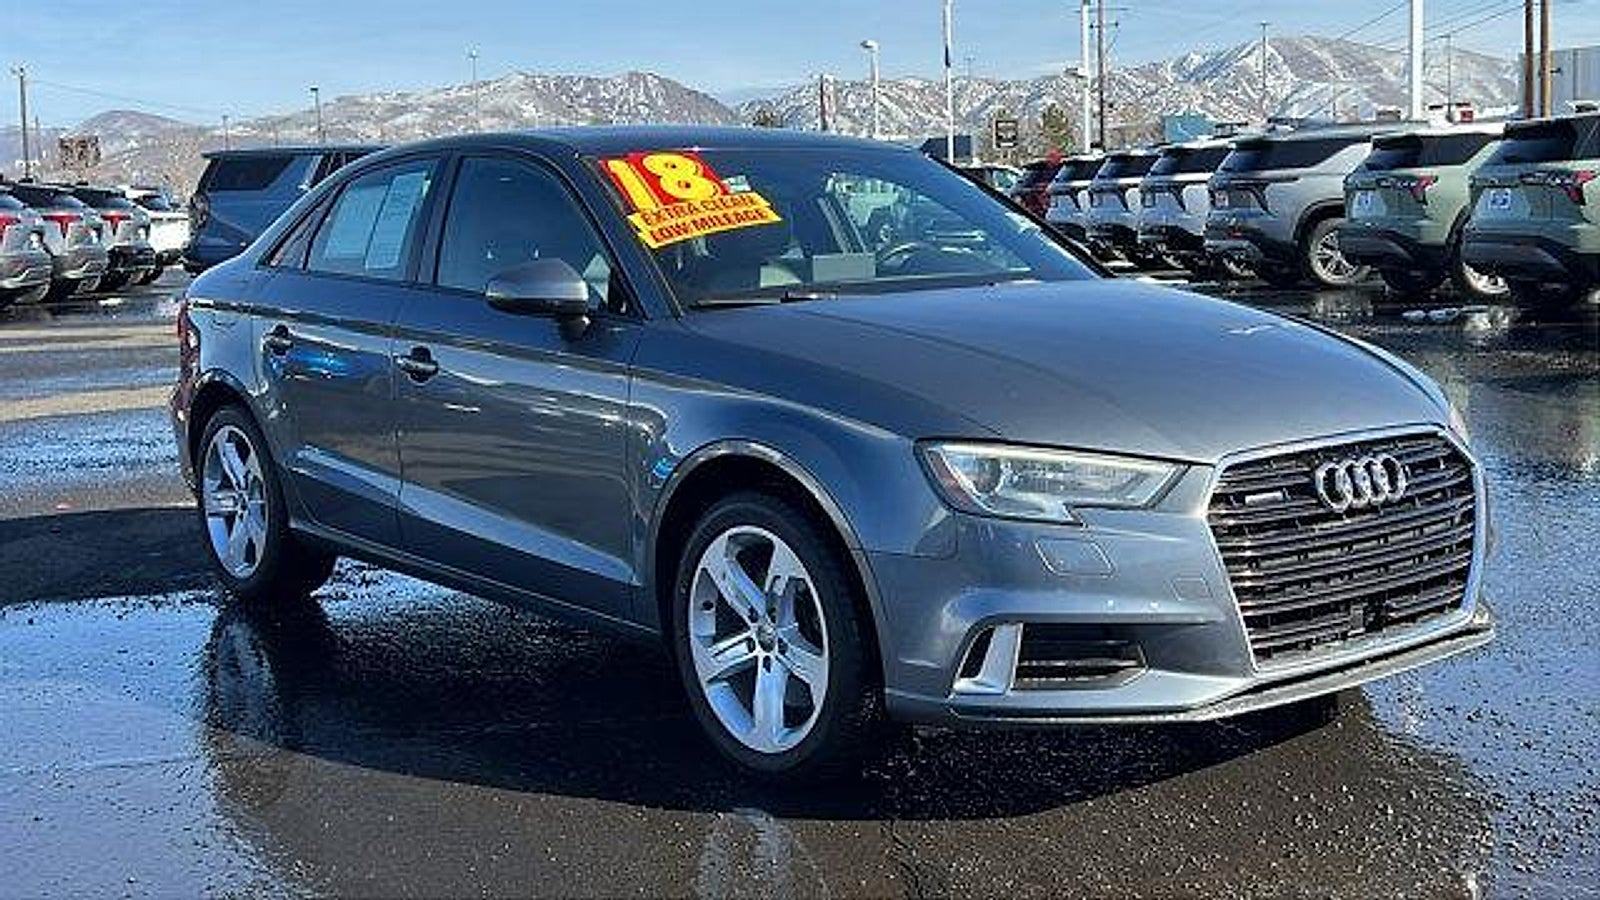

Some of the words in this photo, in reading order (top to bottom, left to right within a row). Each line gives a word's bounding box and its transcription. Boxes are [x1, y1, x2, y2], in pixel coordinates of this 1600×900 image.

[606, 152, 719, 211] 18
[641, 202, 699, 226] EXTRA
[650, 221, 691, 242] LOW
[692, 209, 767, 230] MILEAGE
